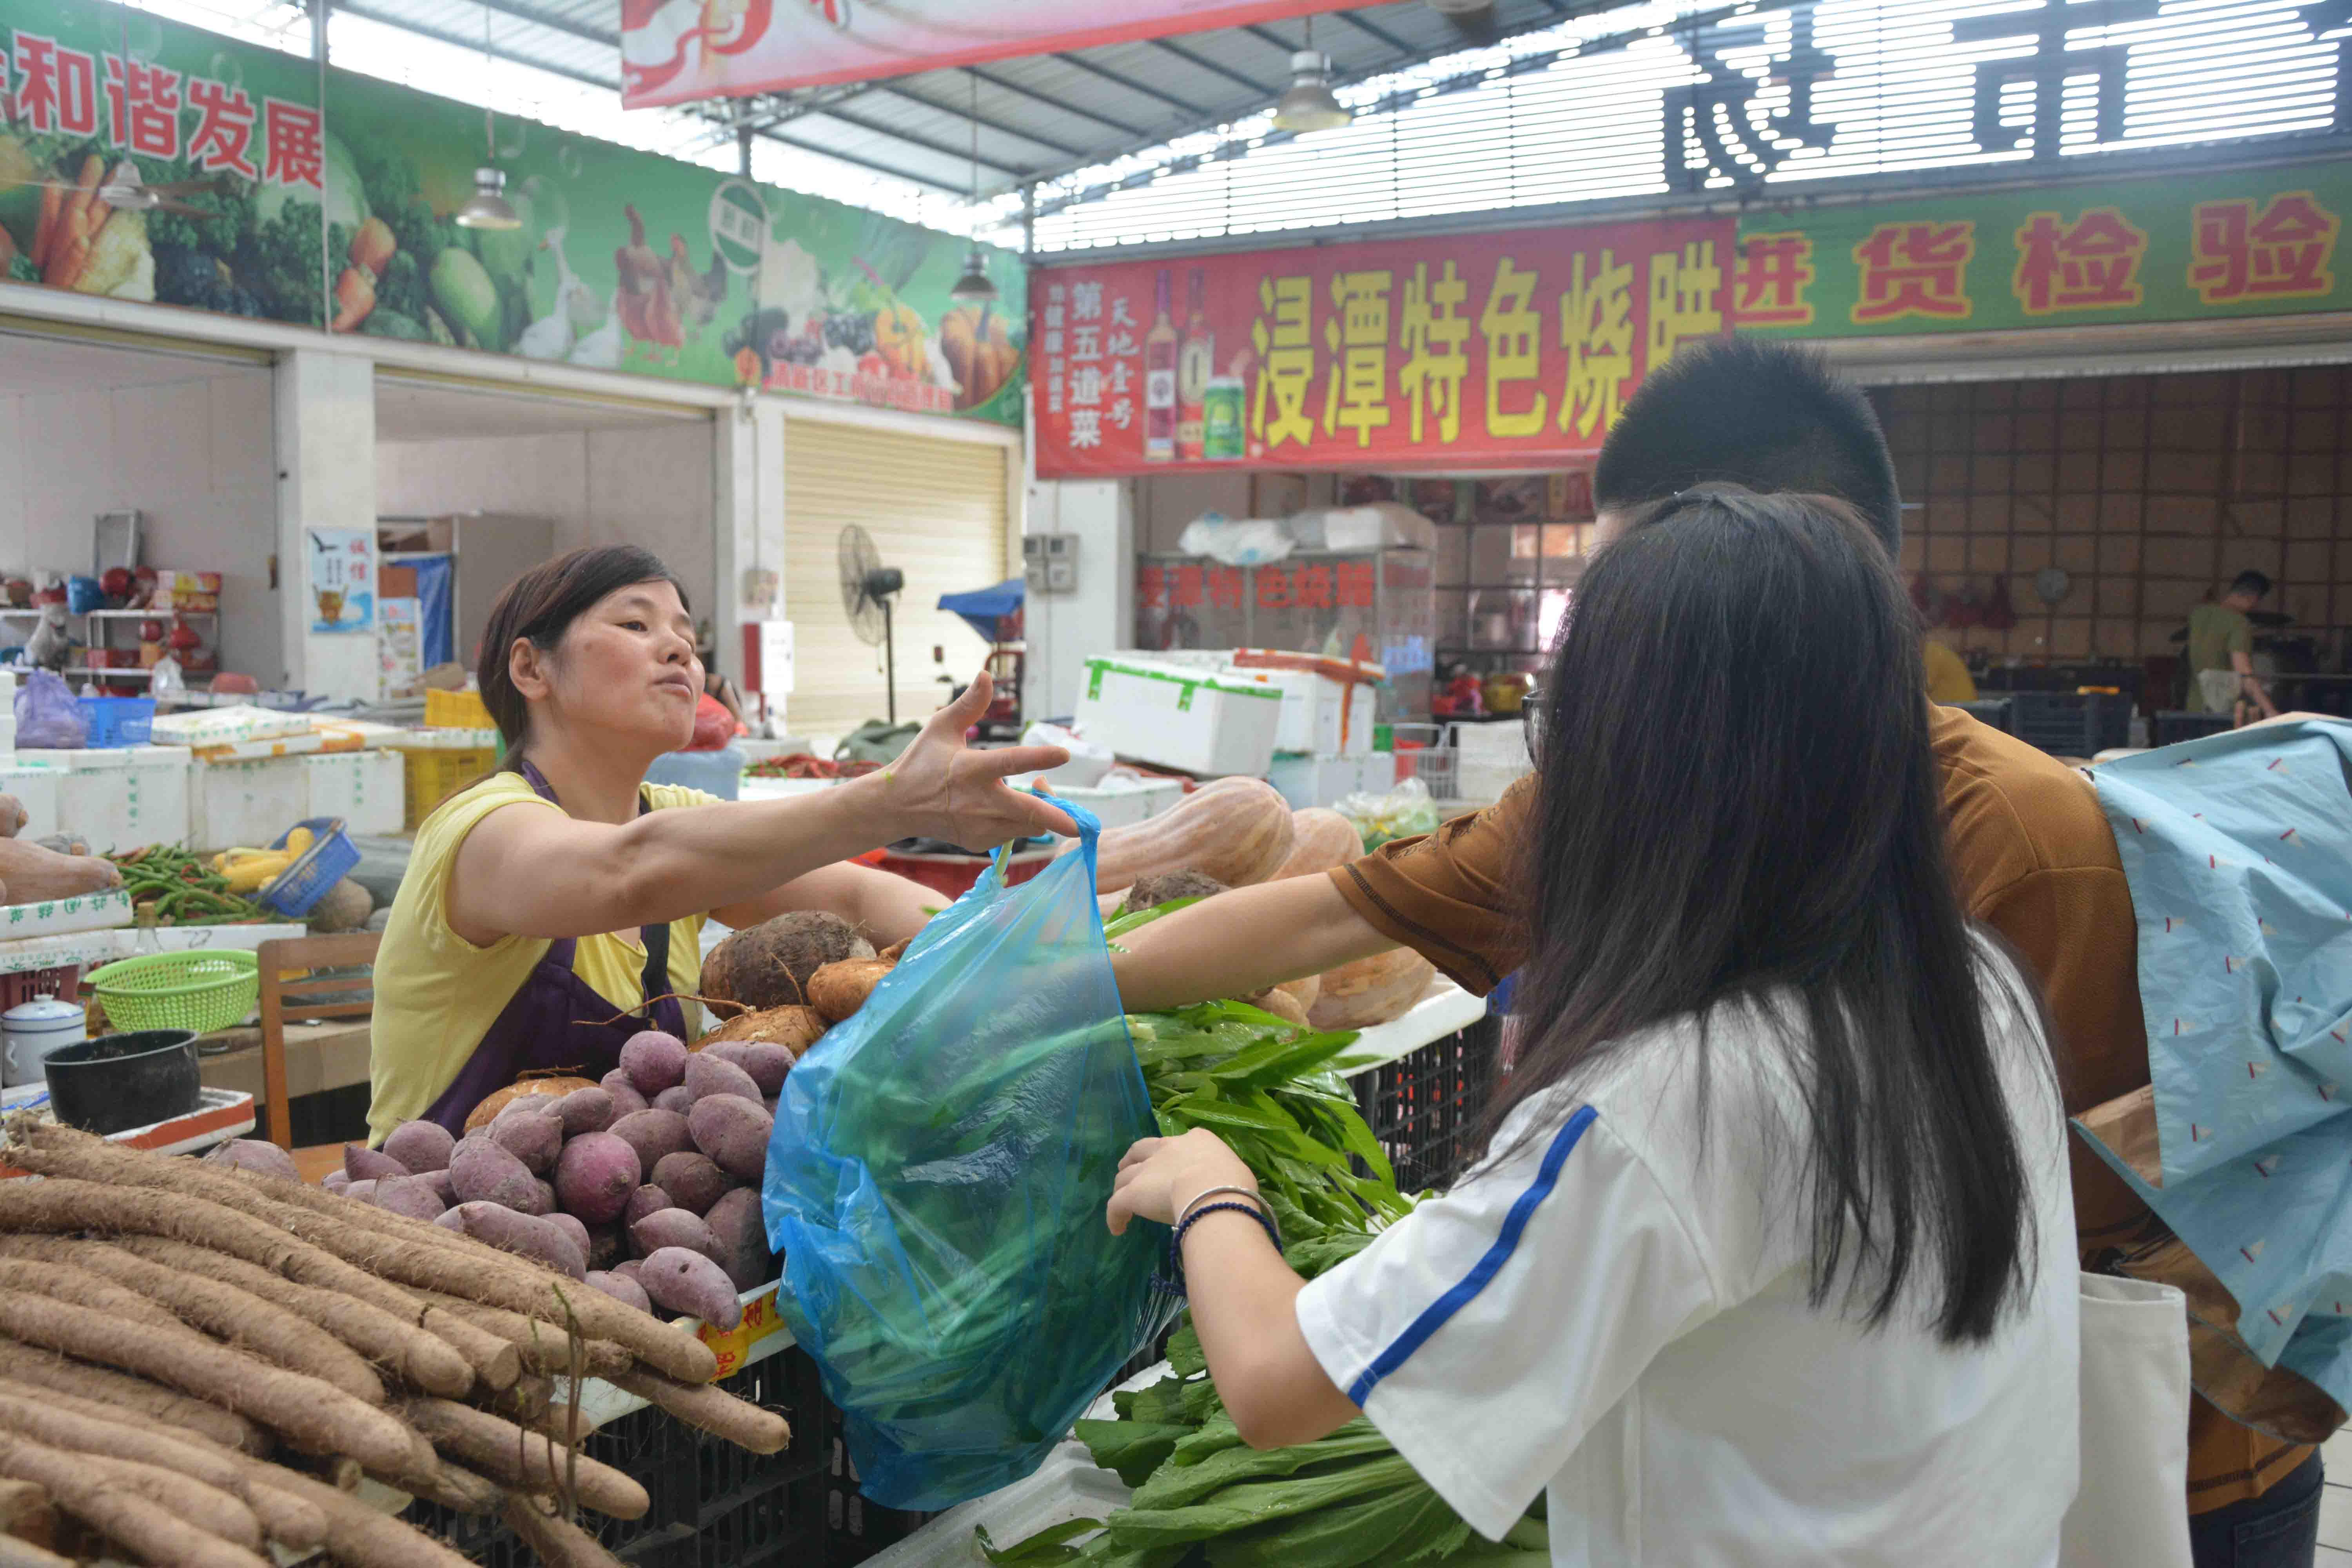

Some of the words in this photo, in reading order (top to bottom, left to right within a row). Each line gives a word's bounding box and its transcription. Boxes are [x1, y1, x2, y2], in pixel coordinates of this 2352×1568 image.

[0, 29, 322, 189] 和谐发展
[1734, 189, 2341, 327] 进货检验
[1069, 281, 1103, 449] 第五道菜
[1103, 296, 1139, 430] 天地壹号
